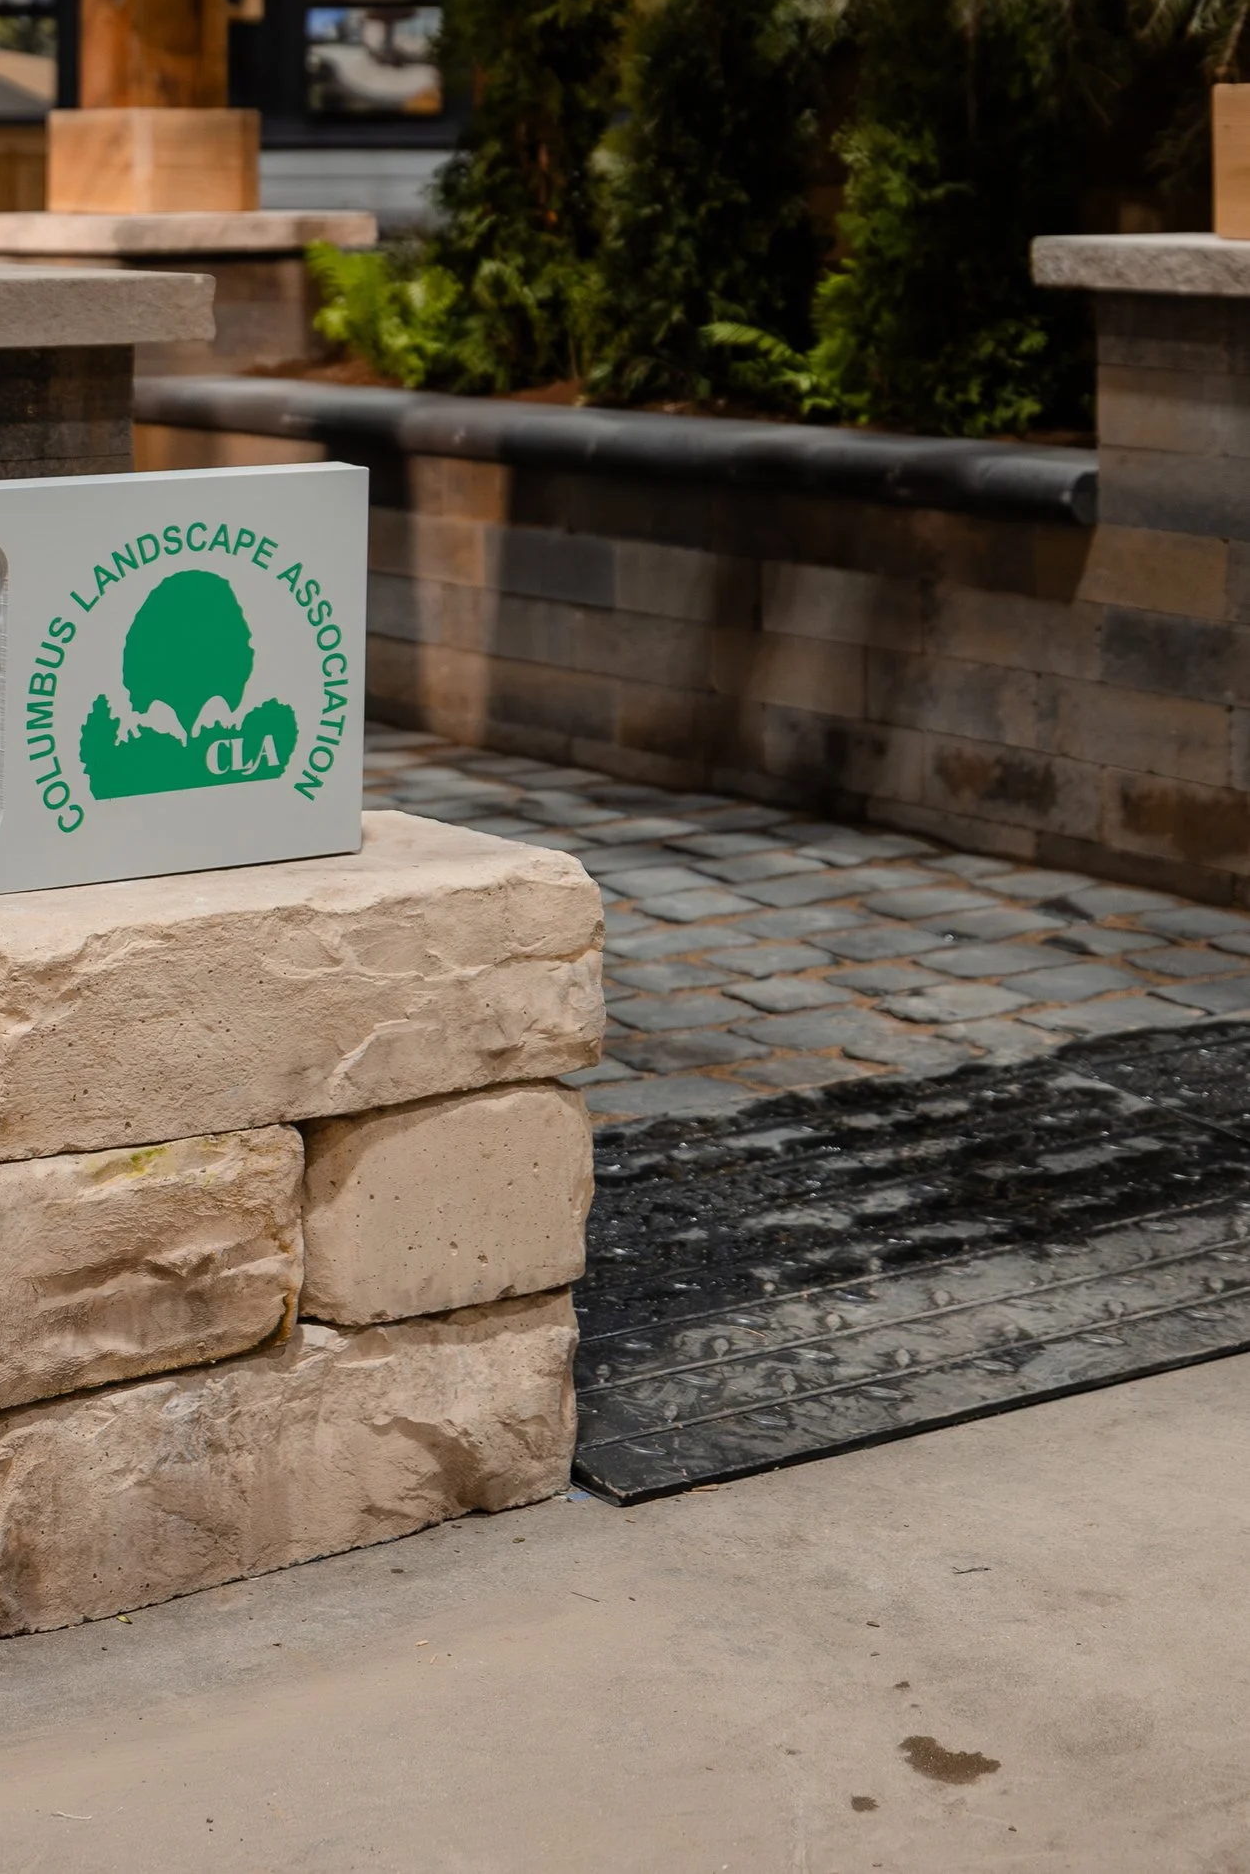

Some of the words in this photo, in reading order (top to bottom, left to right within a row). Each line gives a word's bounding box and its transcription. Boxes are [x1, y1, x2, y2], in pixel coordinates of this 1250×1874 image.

[25, 616, 85, 833] COLUMBUS
[69, 521, 279, 613] LANDSCAPE
[276, 561, 349, 802] ASSOCIATION
[205, 734, 281, 776] CLA
